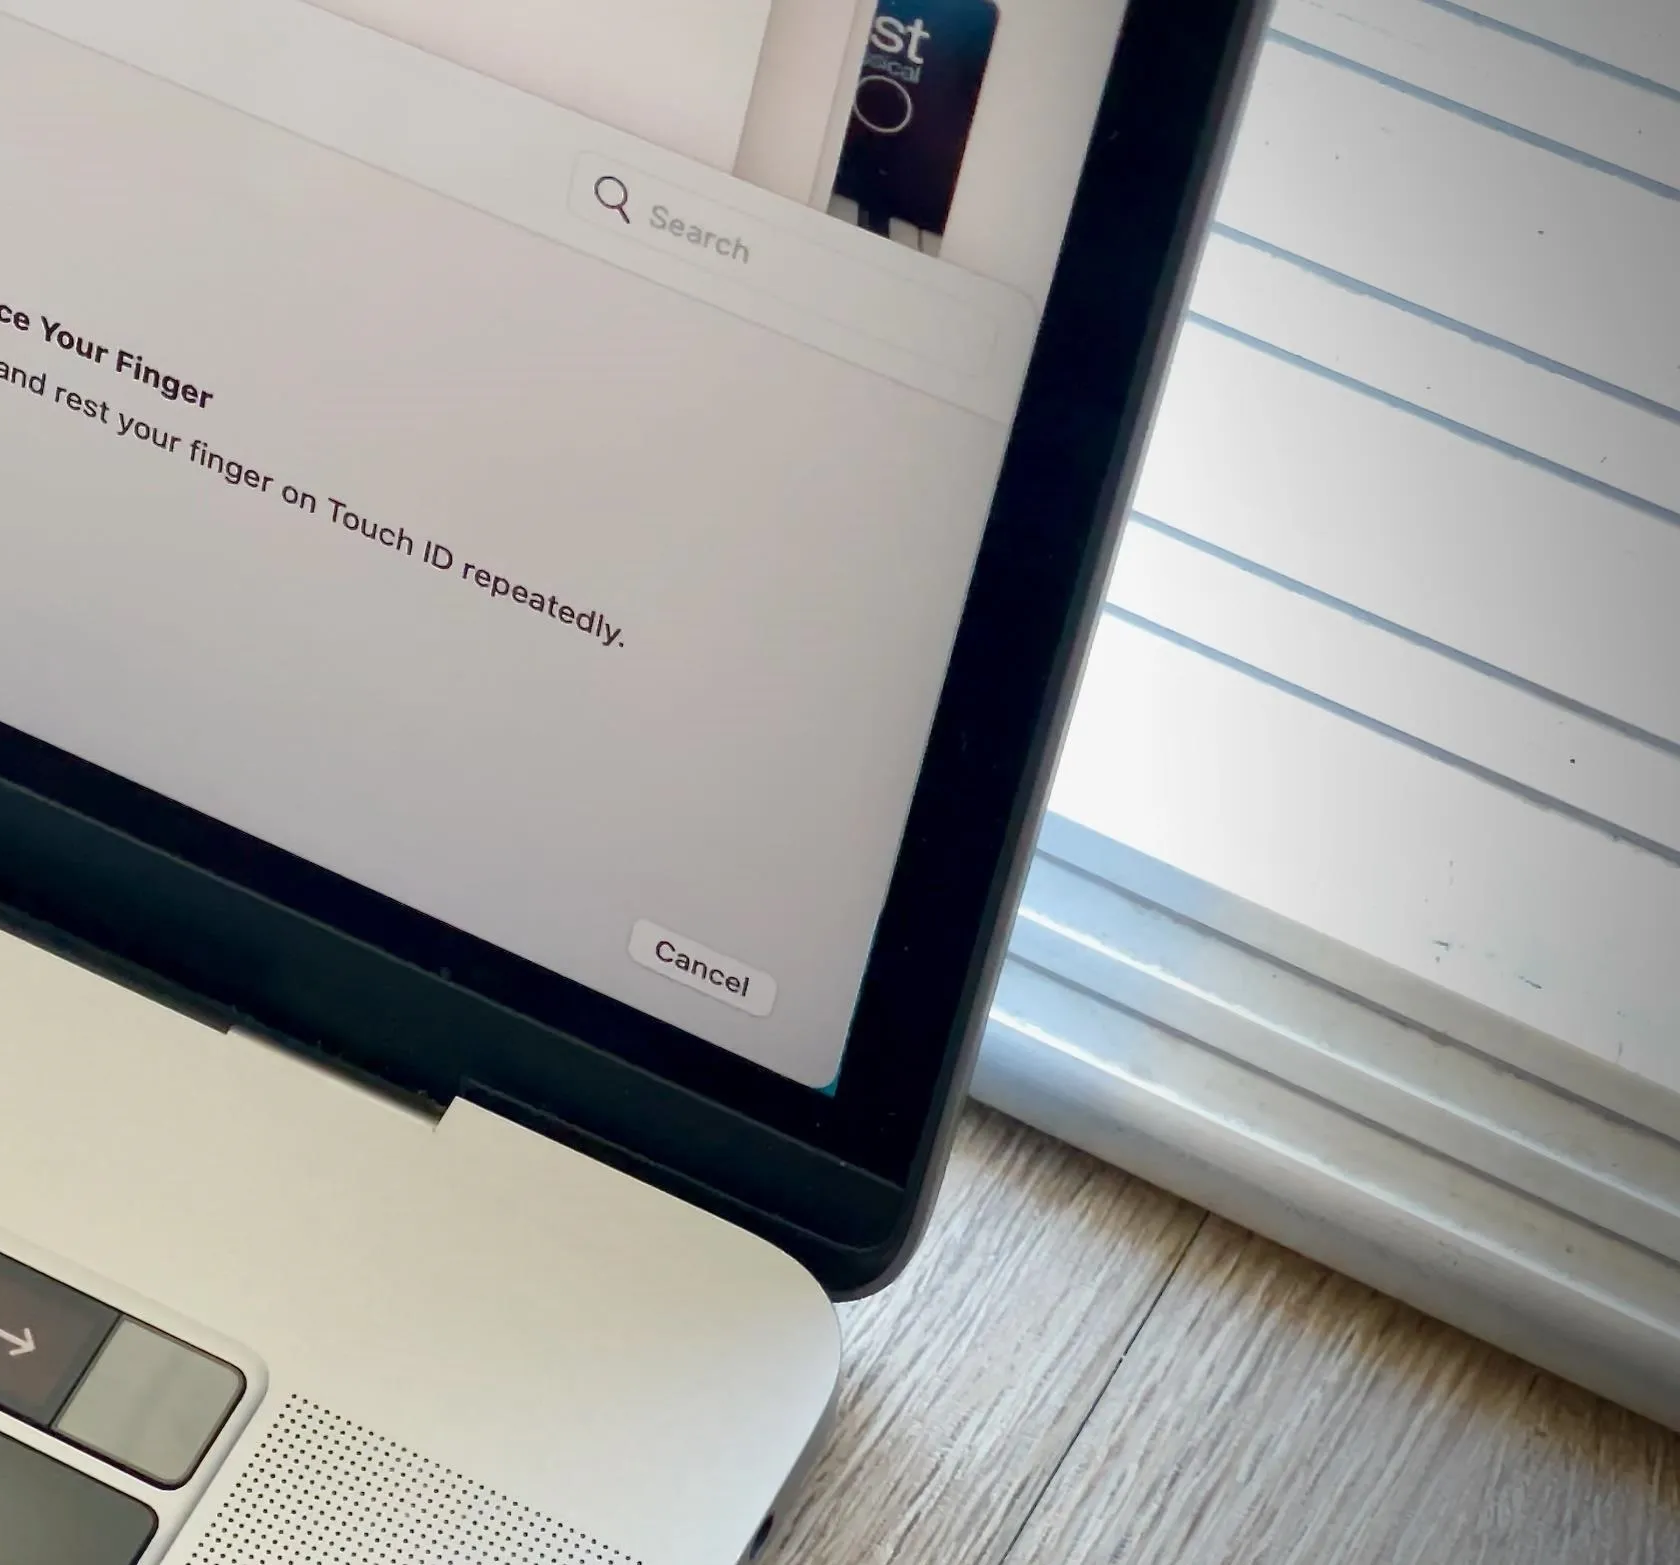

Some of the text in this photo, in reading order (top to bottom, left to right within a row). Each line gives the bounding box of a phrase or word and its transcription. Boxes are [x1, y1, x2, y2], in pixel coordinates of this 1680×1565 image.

[648, 203, 749, 265] Search
[41, 316, 108, 364] Your
[115, 350, 213, 408] Finger
[55, 385, 109, 424] rest
[117, 413, 181, 452] your
[190, 440, 274, 492] finger
[282, 485, 316, 513] on
[328, 497, 413, 556] Touch
[423, 540, 453, 570] ID
[462, 563, 624, 648] repeatedly.
[655, 940, 750, 997] Cancel
